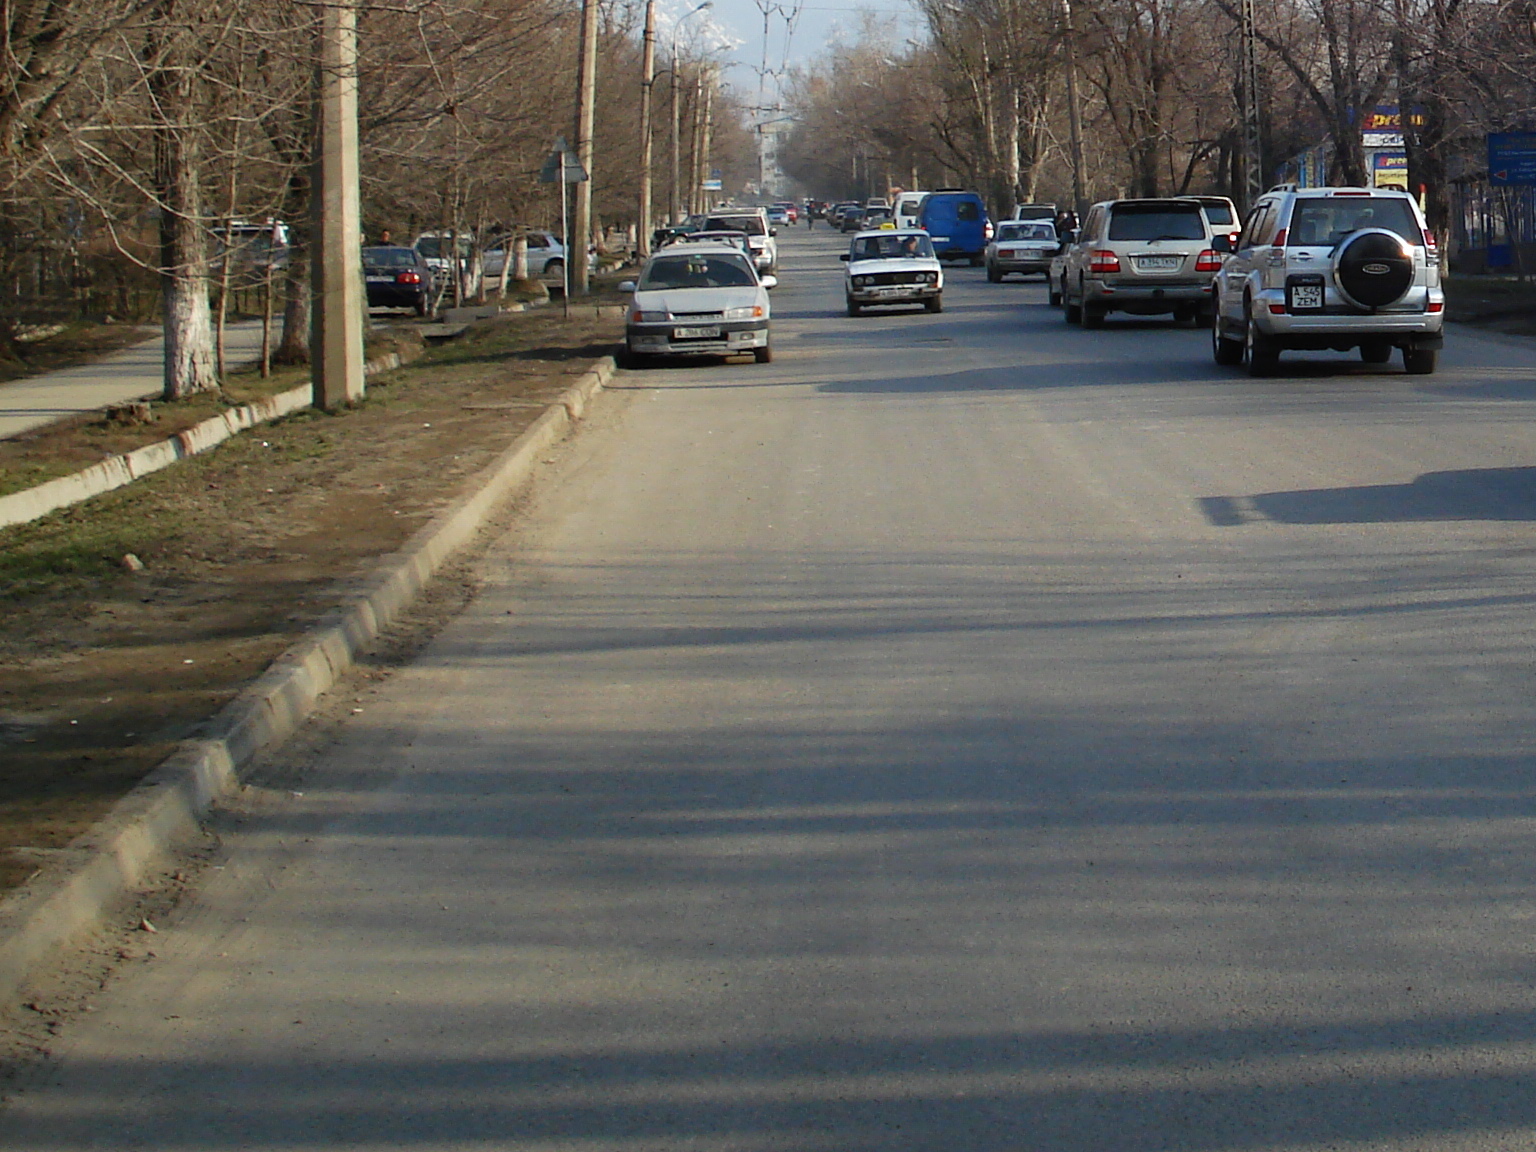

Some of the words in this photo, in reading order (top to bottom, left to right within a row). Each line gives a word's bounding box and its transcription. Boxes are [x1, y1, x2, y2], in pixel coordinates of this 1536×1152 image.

[1293, 286, 1300, 296] A
[1303, 286, 1320, 296] 545
[1297, 297, 1317, 306] ZEM
